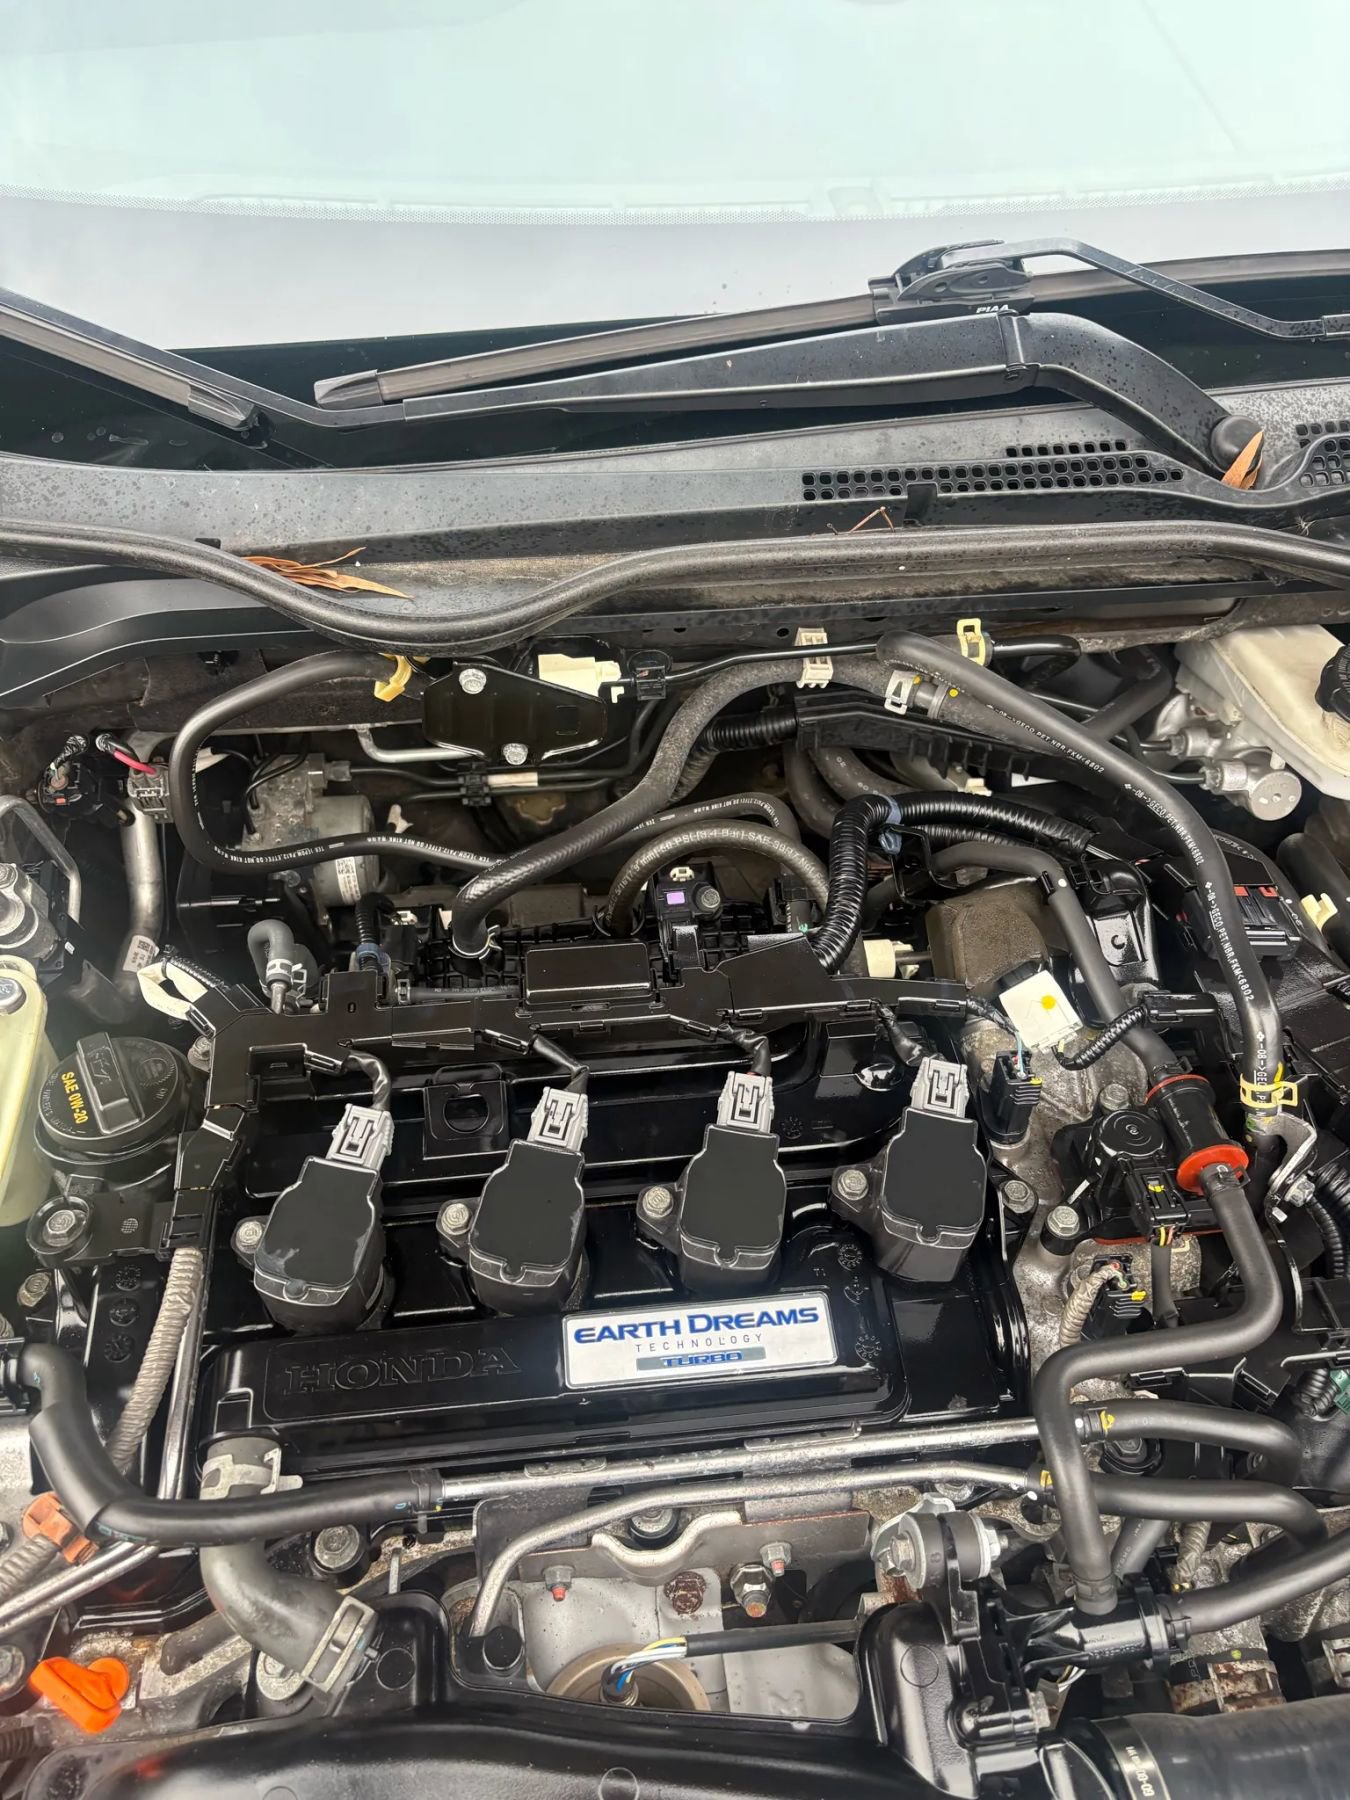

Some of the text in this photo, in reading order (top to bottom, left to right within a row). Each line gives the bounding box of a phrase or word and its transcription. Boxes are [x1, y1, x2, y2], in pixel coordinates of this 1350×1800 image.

[976, 304, 1008, 313] PIAA
[61, 1072, 79, 1093] SAE
[68, 1092, 89, 1124] 0W-20
[574, 1306, 819, 1344] EARTH DREAMS
[635, 1333, 764, 1352] TECHNOLOGY
[662, 1350, 742, 1367] TURBO
[283, 1348, 521, 1395] HONDA
